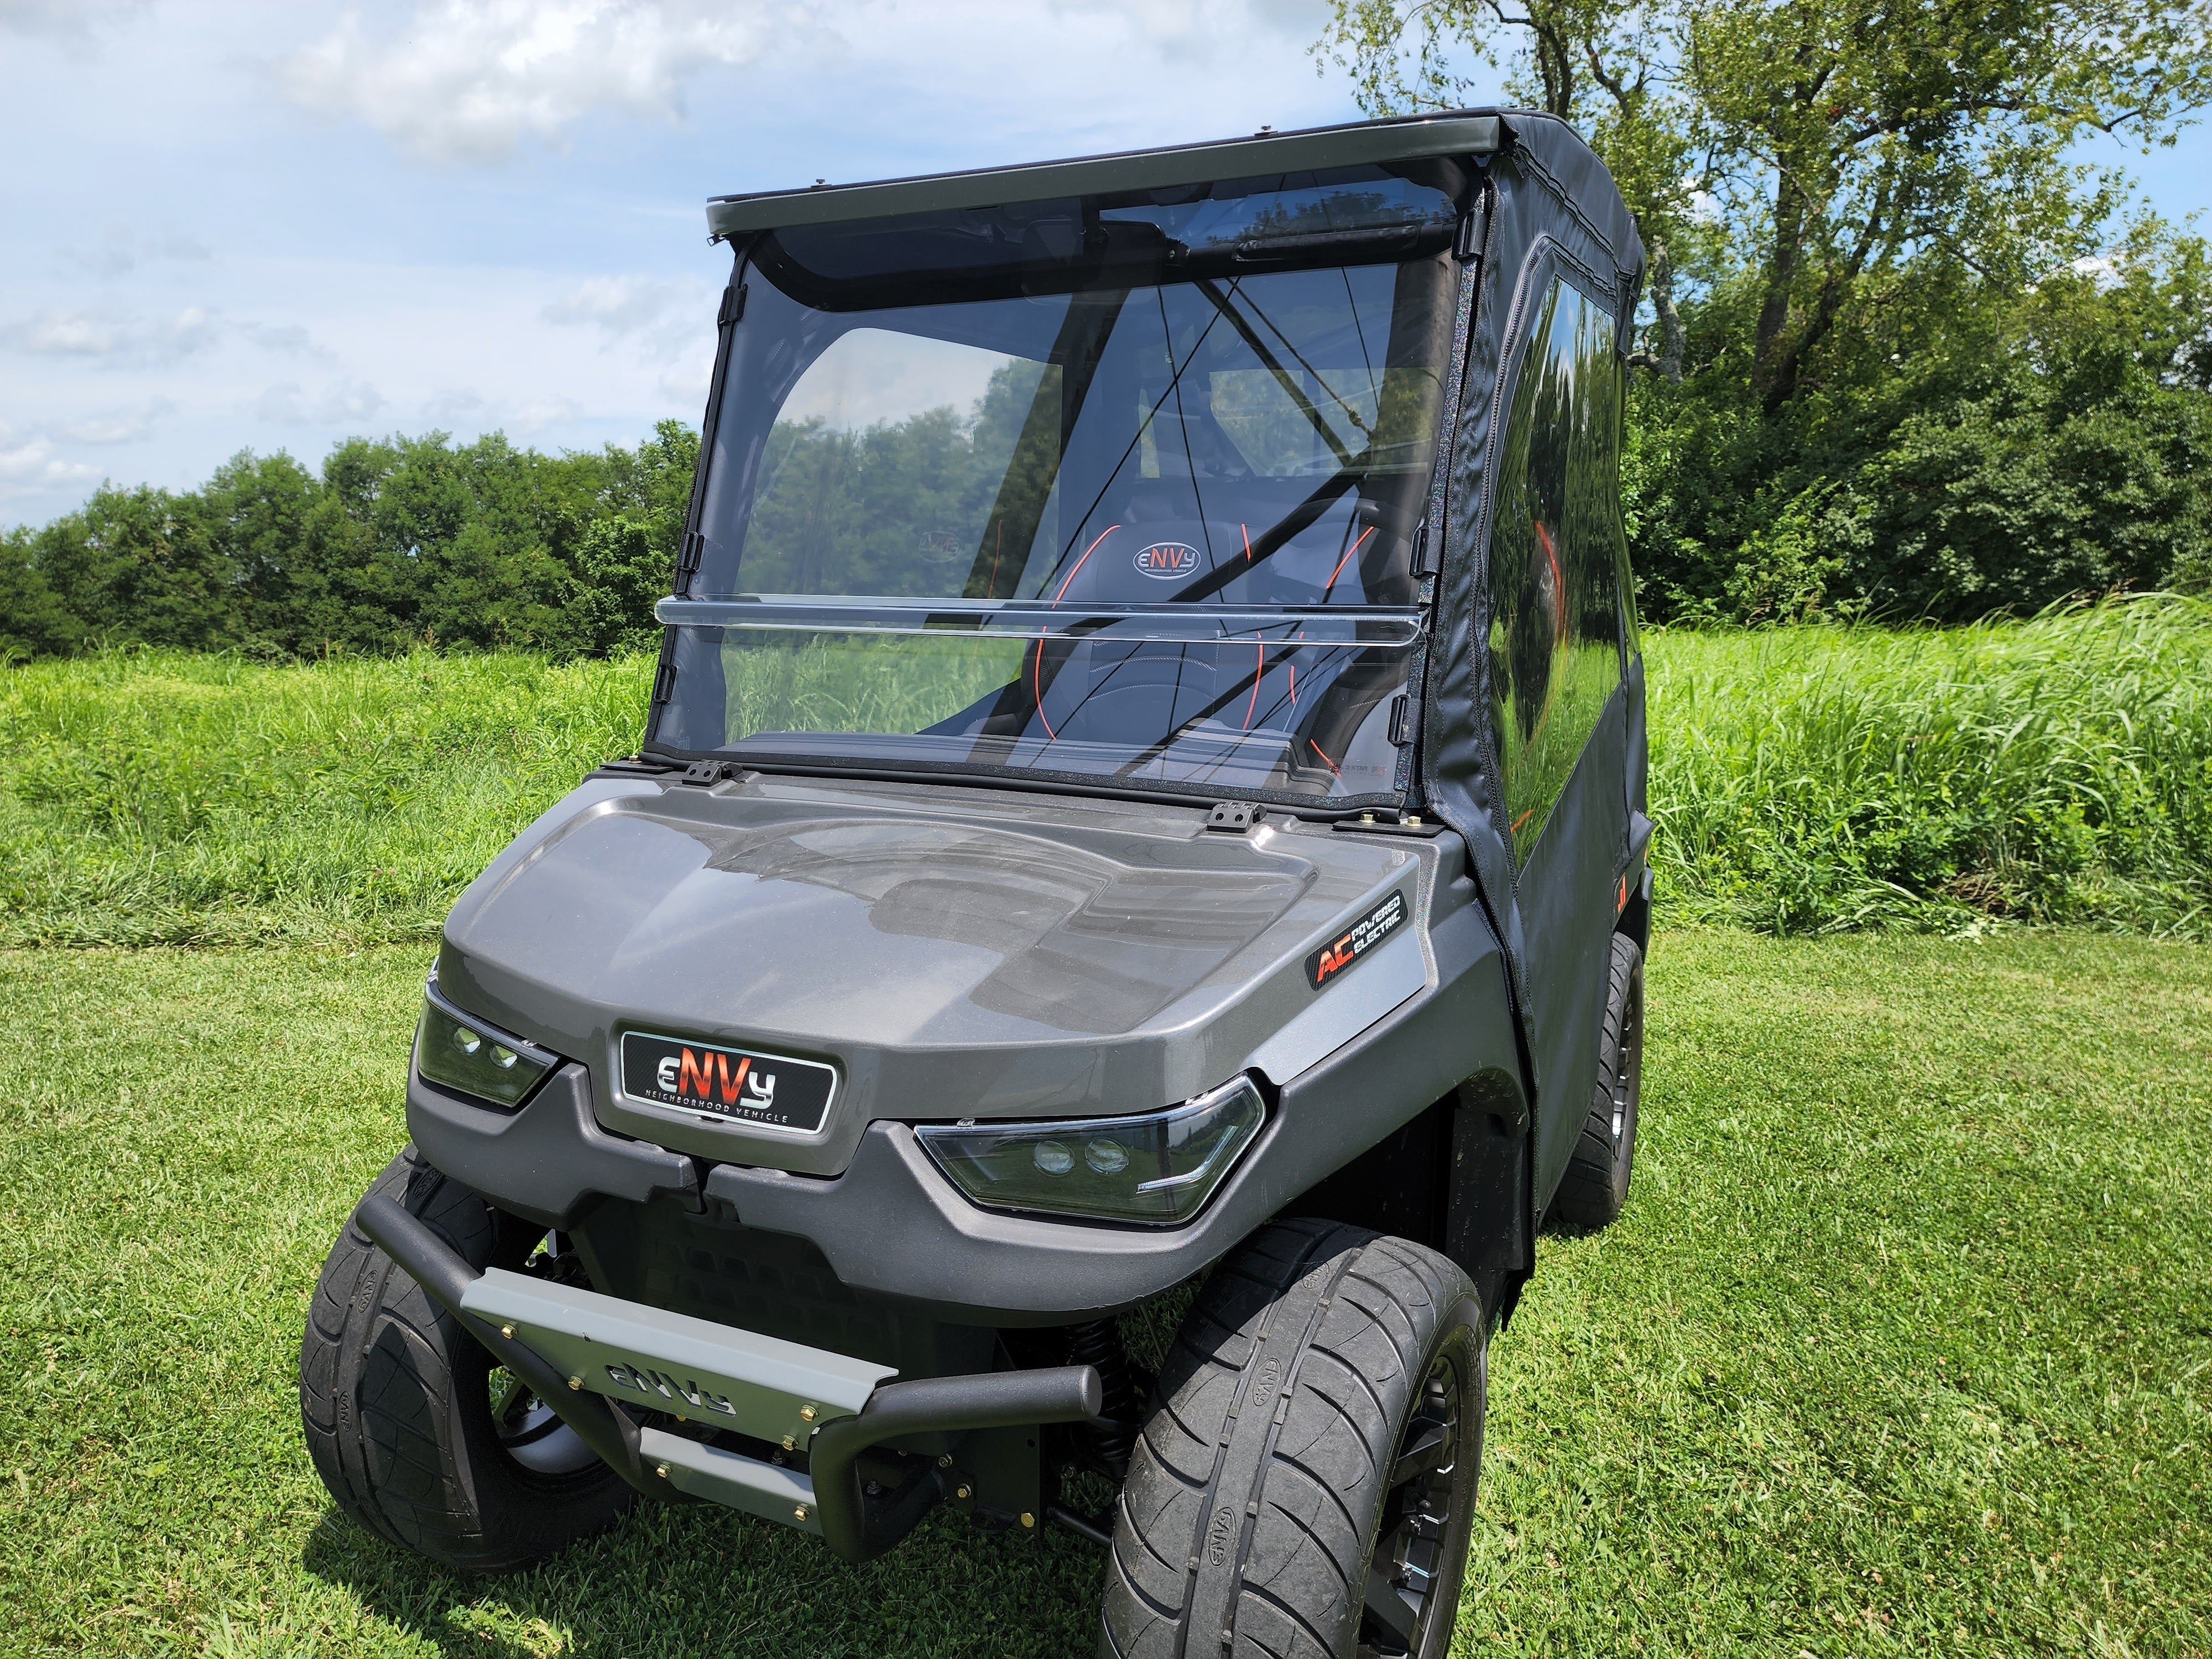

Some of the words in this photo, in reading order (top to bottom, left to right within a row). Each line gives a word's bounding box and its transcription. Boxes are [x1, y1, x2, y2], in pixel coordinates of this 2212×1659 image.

[1351, 895, 1401, 941] POWERED
[1354, 909, 1401, 954] ELECTRIC
[1317, 933, 1354, 982] AC
[645, 1089, 729, 1113] NEIGHBORHOOD
[736, 1107, 788, 1124] VEHICLE
